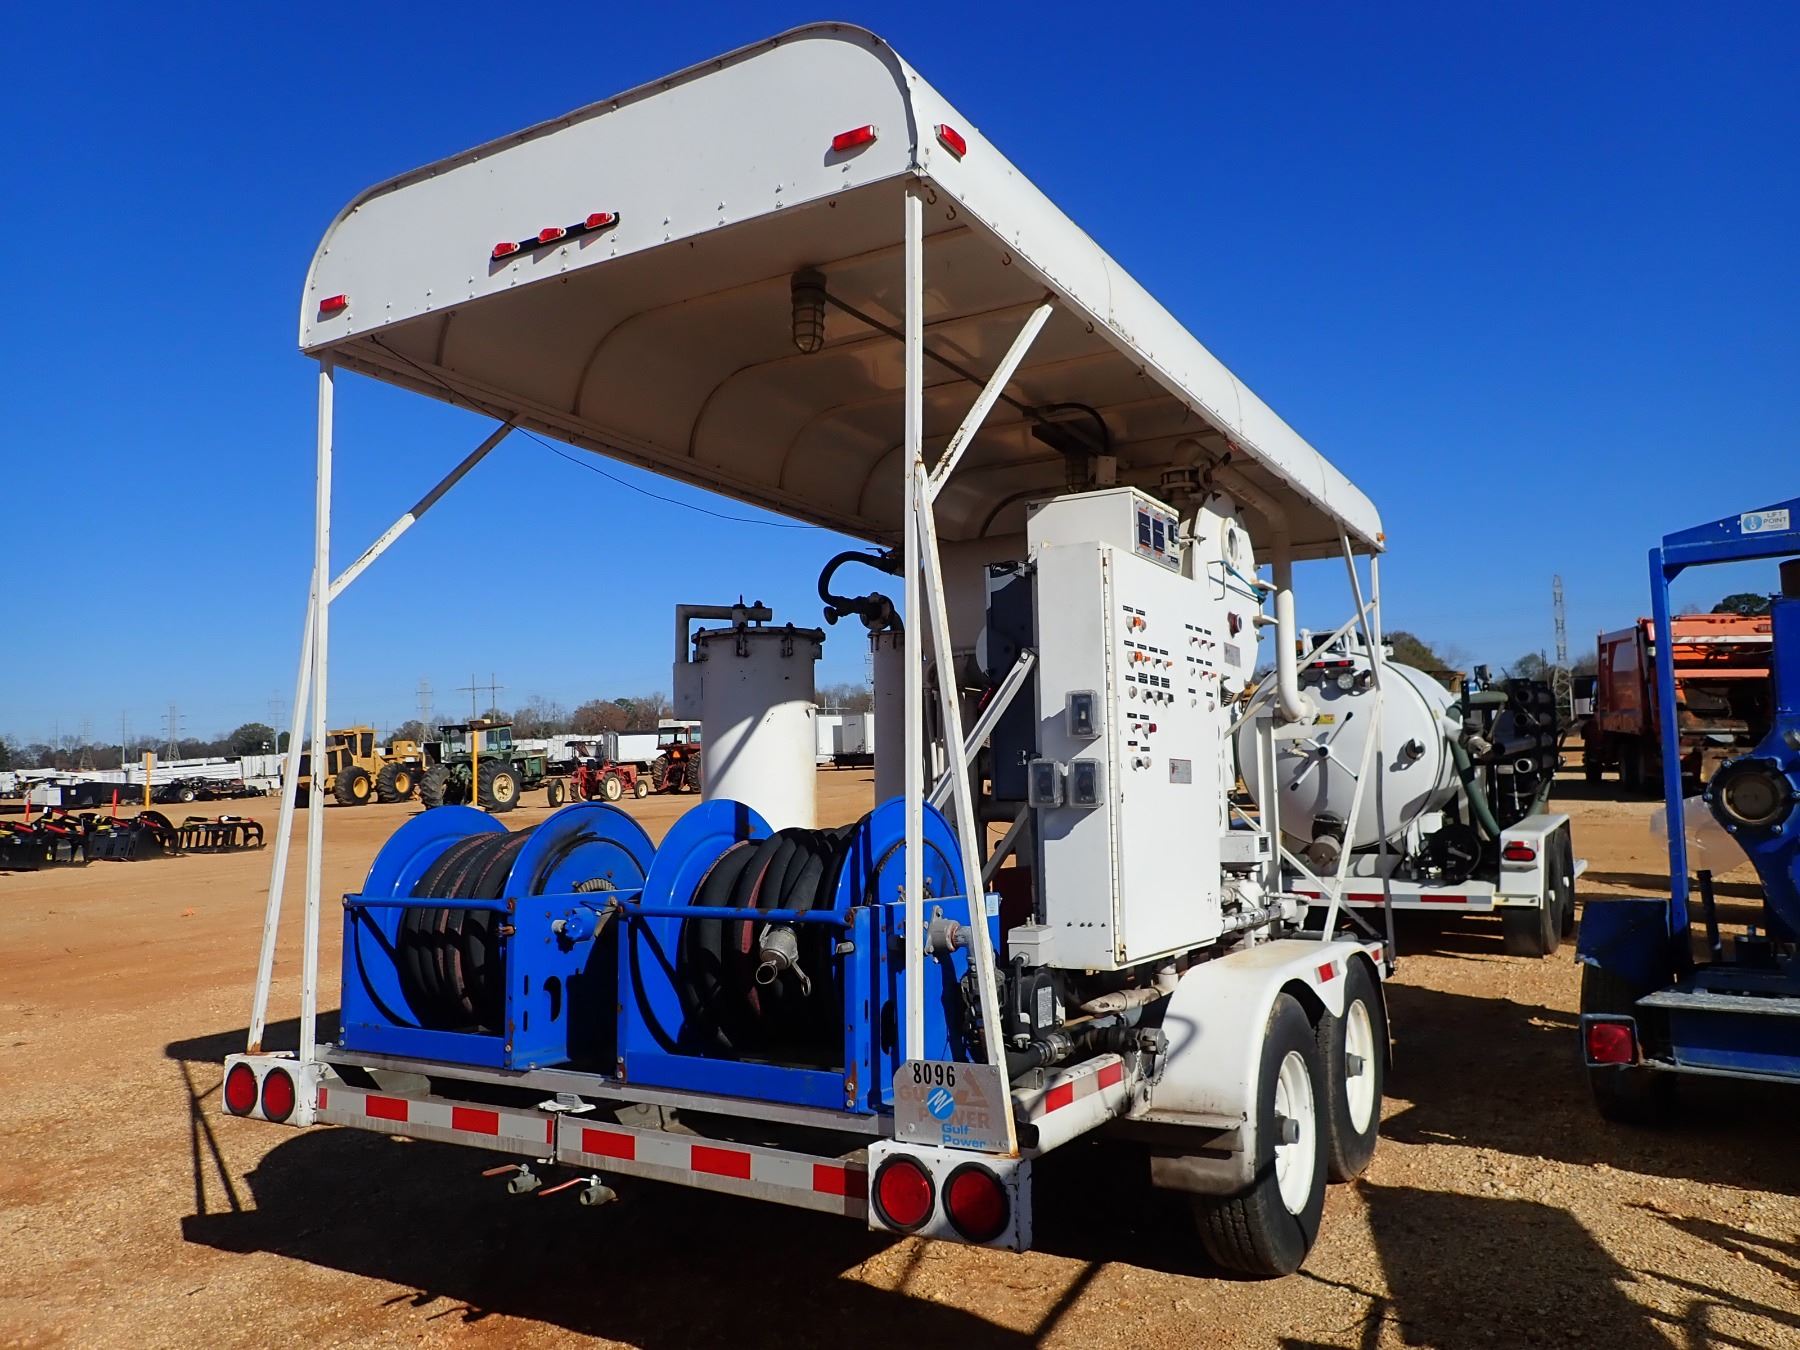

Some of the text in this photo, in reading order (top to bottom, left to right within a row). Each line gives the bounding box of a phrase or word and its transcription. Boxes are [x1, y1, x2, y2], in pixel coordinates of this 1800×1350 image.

[913, 1062, 956, 1088] 8096
[941, 1122, 969, 1135] Gulf
[942, 1134, 987, 1149] Power
